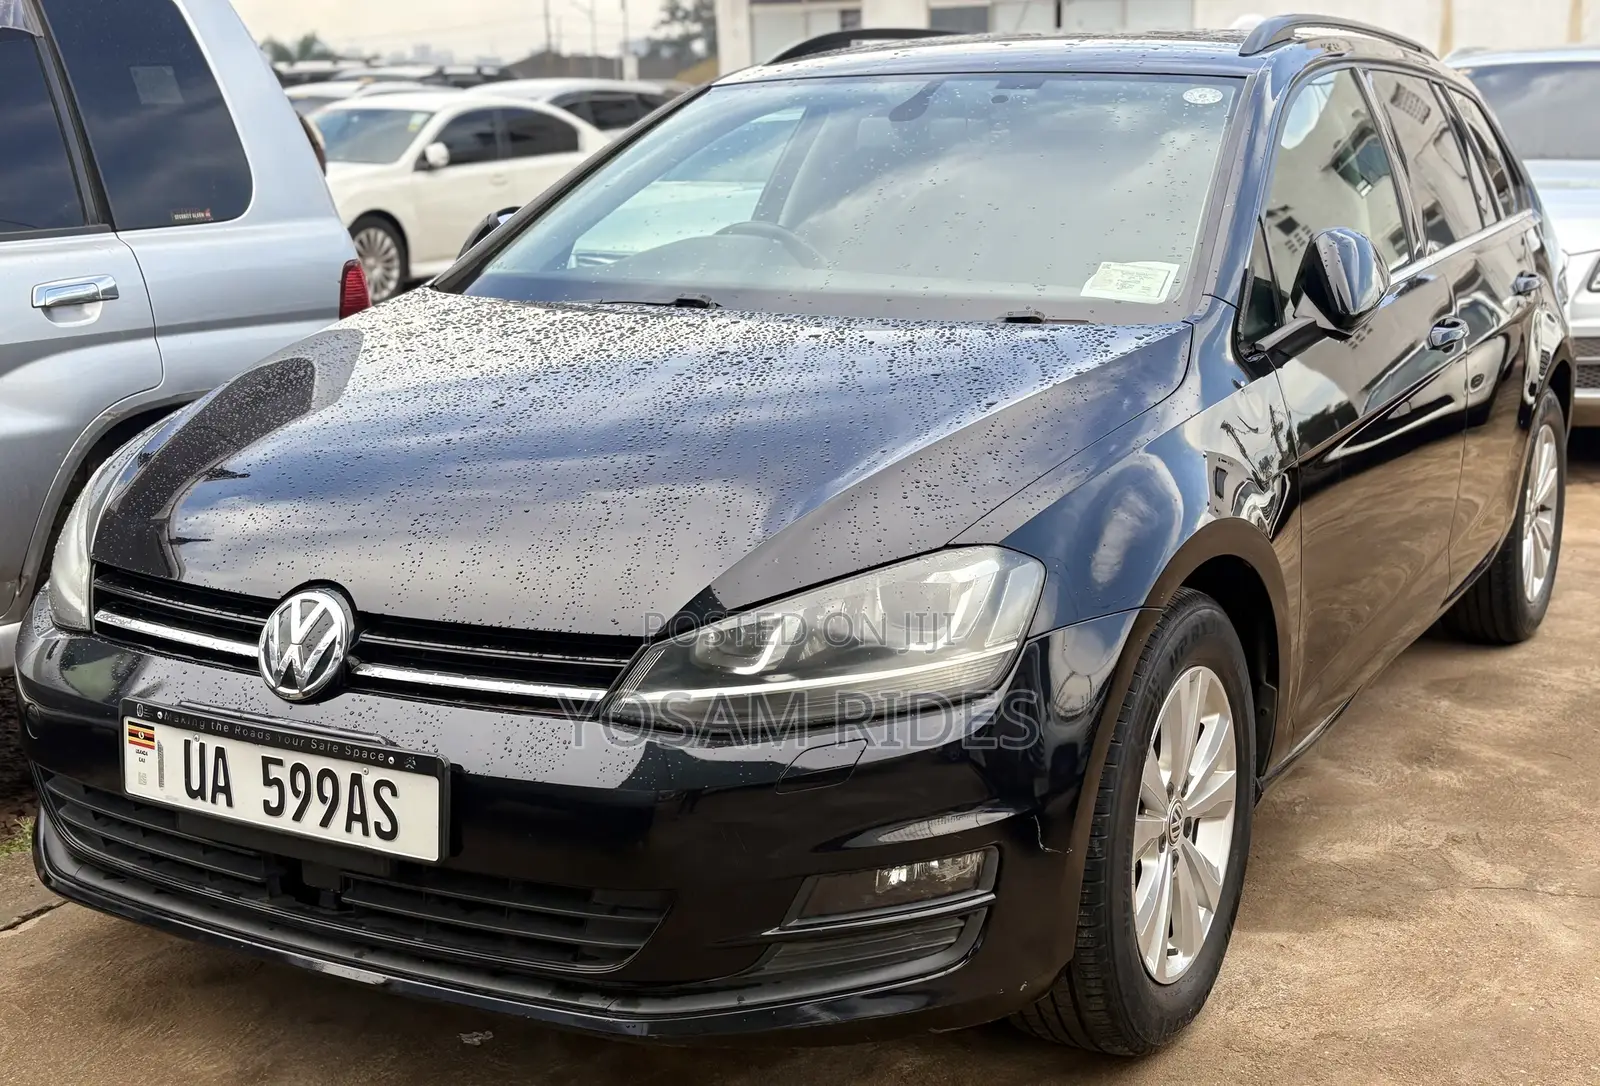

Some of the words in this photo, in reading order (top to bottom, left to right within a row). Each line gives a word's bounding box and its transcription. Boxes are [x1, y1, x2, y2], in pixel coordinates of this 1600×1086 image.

[164, 711, 205, 730] Making
[211, 721, 229, 733] the
[234, 725, 271, 741] Roads
[277, 733, 305, 747] Your
[310, 739, 339, 753] Safe
[345, 745, 385, 762] Space
[183, 738, 234, 808] UA
[261, 755, 399, 841] 599AS
